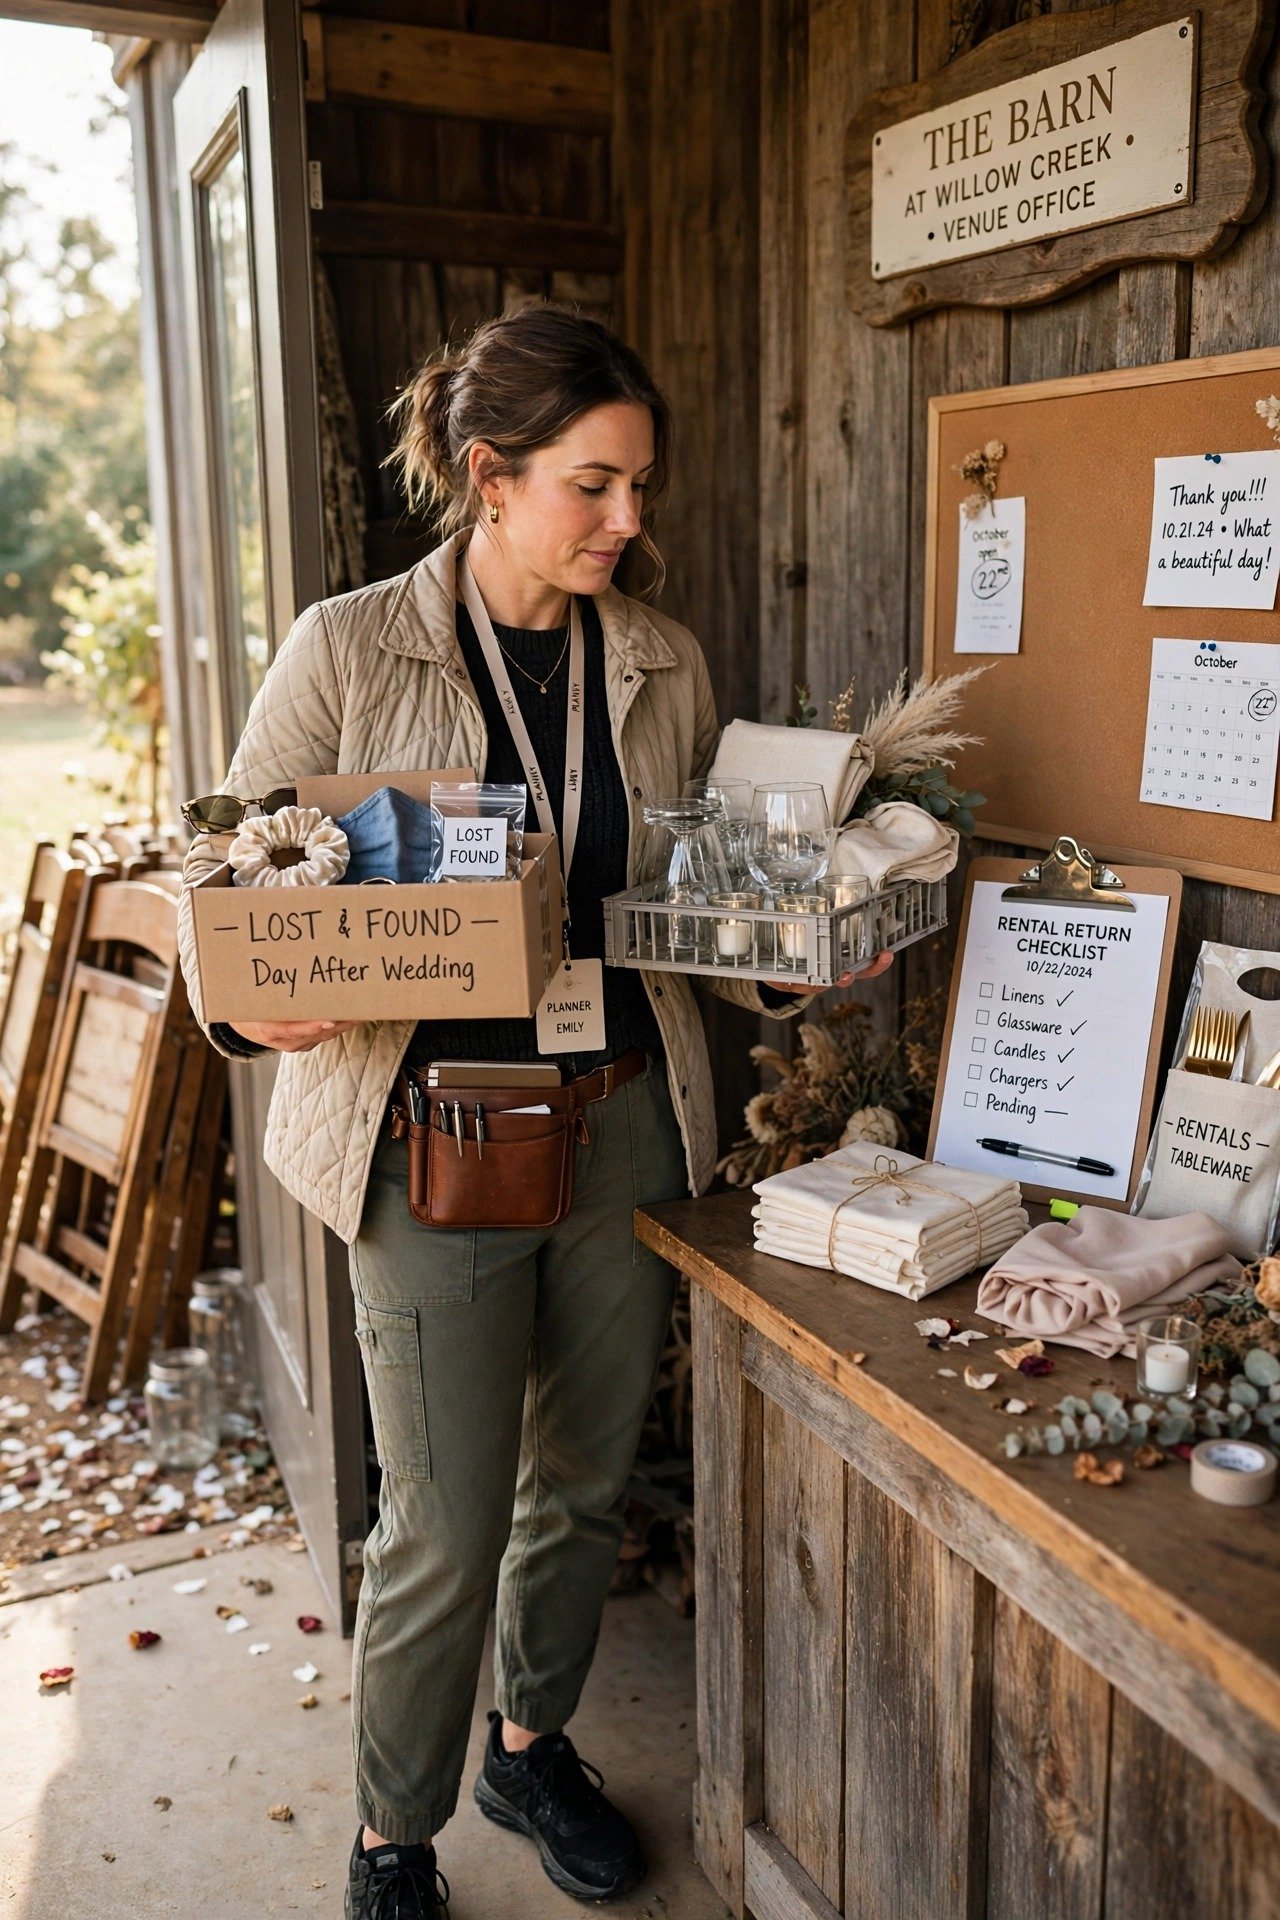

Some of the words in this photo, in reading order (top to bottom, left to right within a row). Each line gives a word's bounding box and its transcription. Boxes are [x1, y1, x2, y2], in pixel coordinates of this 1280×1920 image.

[924, 110, 994, 171] THE
[1007, 66, 1117, 146] BARN
[905, 189, 926, 217] AT
[935, 161, 1021, 208] WILLOW
[1030, 132, 1112, 182] CREEK
[944, 205, 1008, 243] VENUE
[1017, 180, 1096, 224] OFFICE
[1169, 483, 1215, 507] Thank
[1220, 477, 1267, 515] you!!!
[1162, 520, 1214, 539] 10.21.24
[1234, 518, 1272, 538] What
[1158, 557, 1167, 569] a
[1171, 548, 1233, 577] beautiful
[1237, 546, 1272, 582] day!
[1194, 654, 1238, 669] October
[456, 827, 494, 842] LOST
[449, 849, 499, 864] FOUND
[249, 910, 322, 943] LOST
[367, 907, 461, 940] FOUND
[997, 916, 1059, 936] RENTAL
[1064, 922, 1131, 942] RETURN
[1016, 938, 1107, 961] CHECKLIST
[251, 957, 297, 998] Day
[310, 955, 369, 985] After
[381, 954, 475, 992] Wedding
[1026, 960, 1093, 979] 10/22/2024
[547, 1000, 592, 1013] PLANNER
[1001, 984, 1044, 1006] Linens
[556, 1021, 584, 1034] EMILY
[997, 1012, 1063, 1036] Glassware
[993, 1039, 1046, 1062] Candles
[989, 1067, 1048, 1094] Chargers
[986, 1093, 1036, 1124] Pending
[1176, 1116, 1251, 1151] RENTALS
[1170, 1147, 1253, 1183] TABLEWARE
